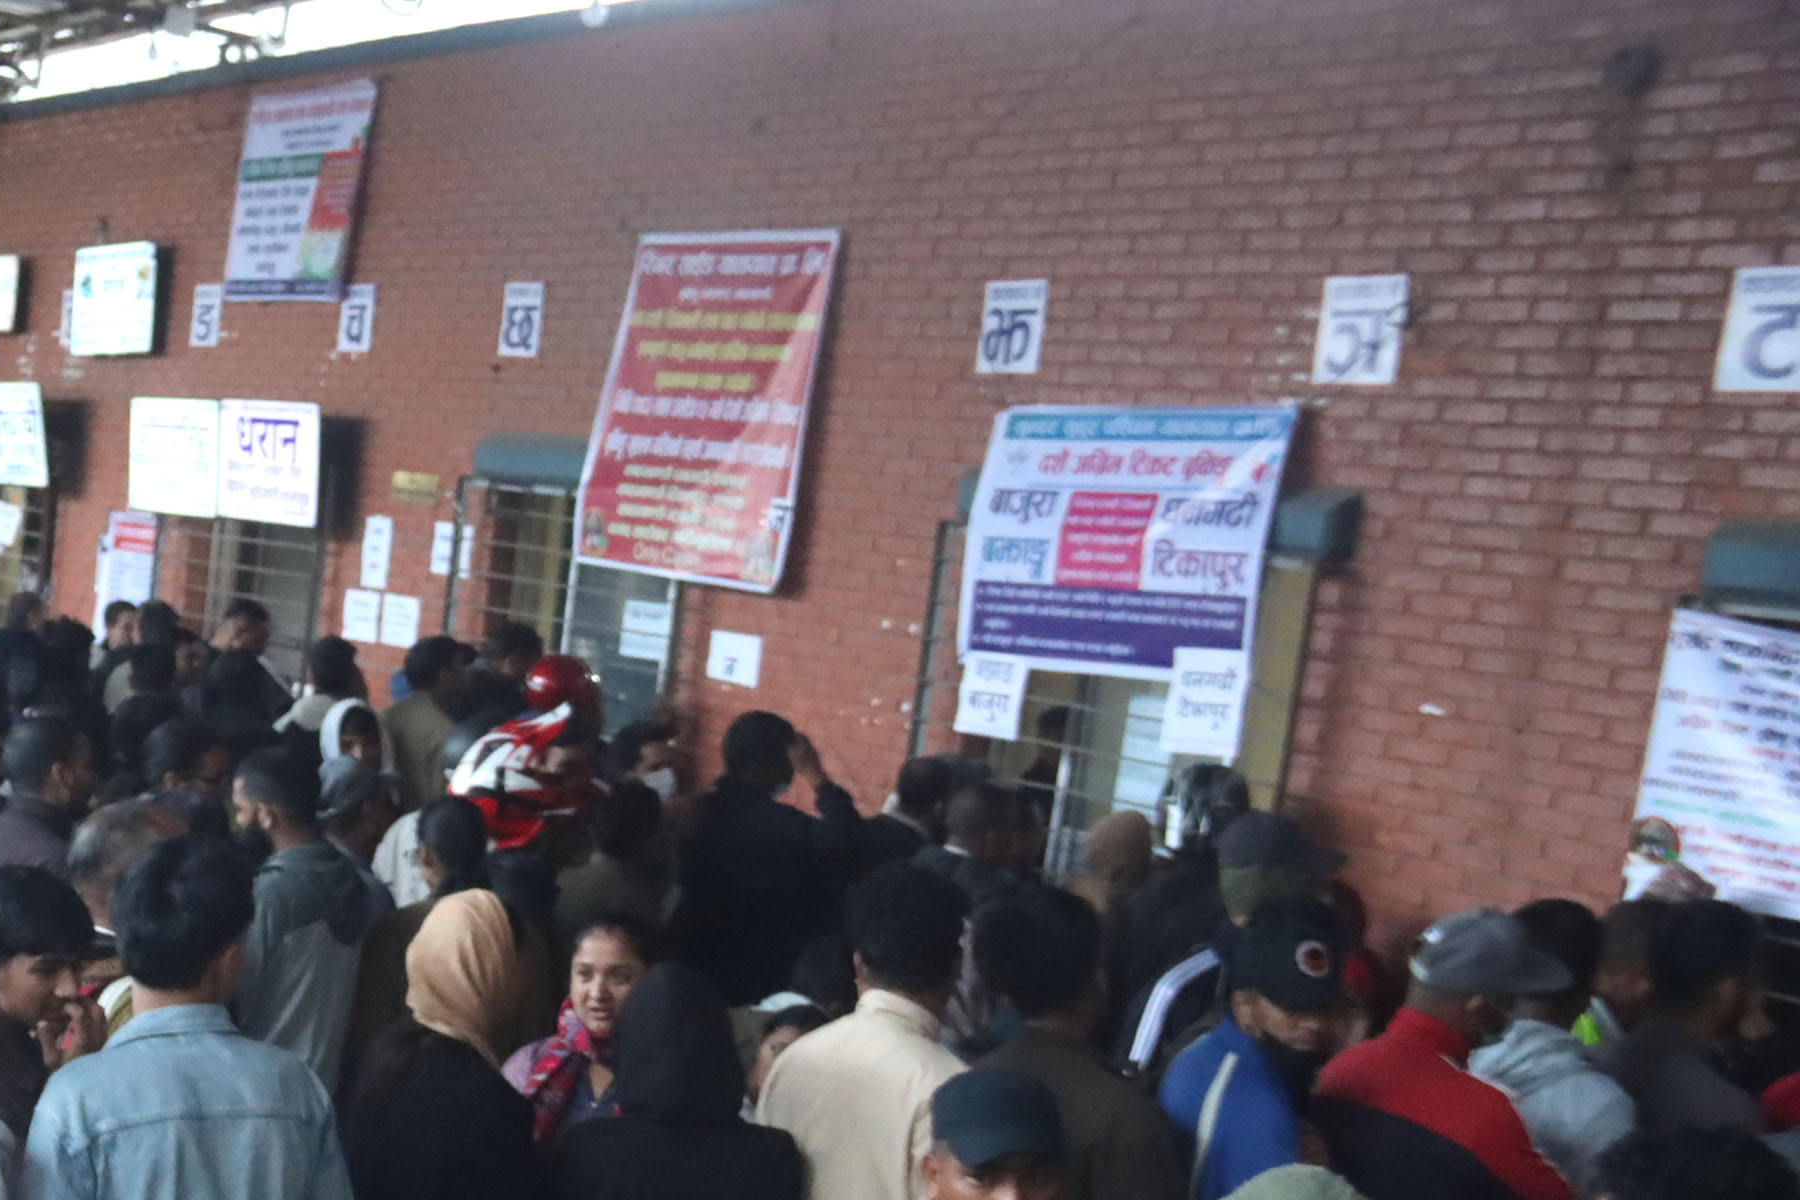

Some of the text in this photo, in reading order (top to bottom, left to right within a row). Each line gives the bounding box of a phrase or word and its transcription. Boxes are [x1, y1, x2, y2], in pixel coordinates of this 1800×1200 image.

[503, 306, 538, 350] छ
[237, 415, 299, 464] धरान
[989, 489, 1059, 522] बाजुरा
[1152, 537, 1249, 591] टिकापुर
